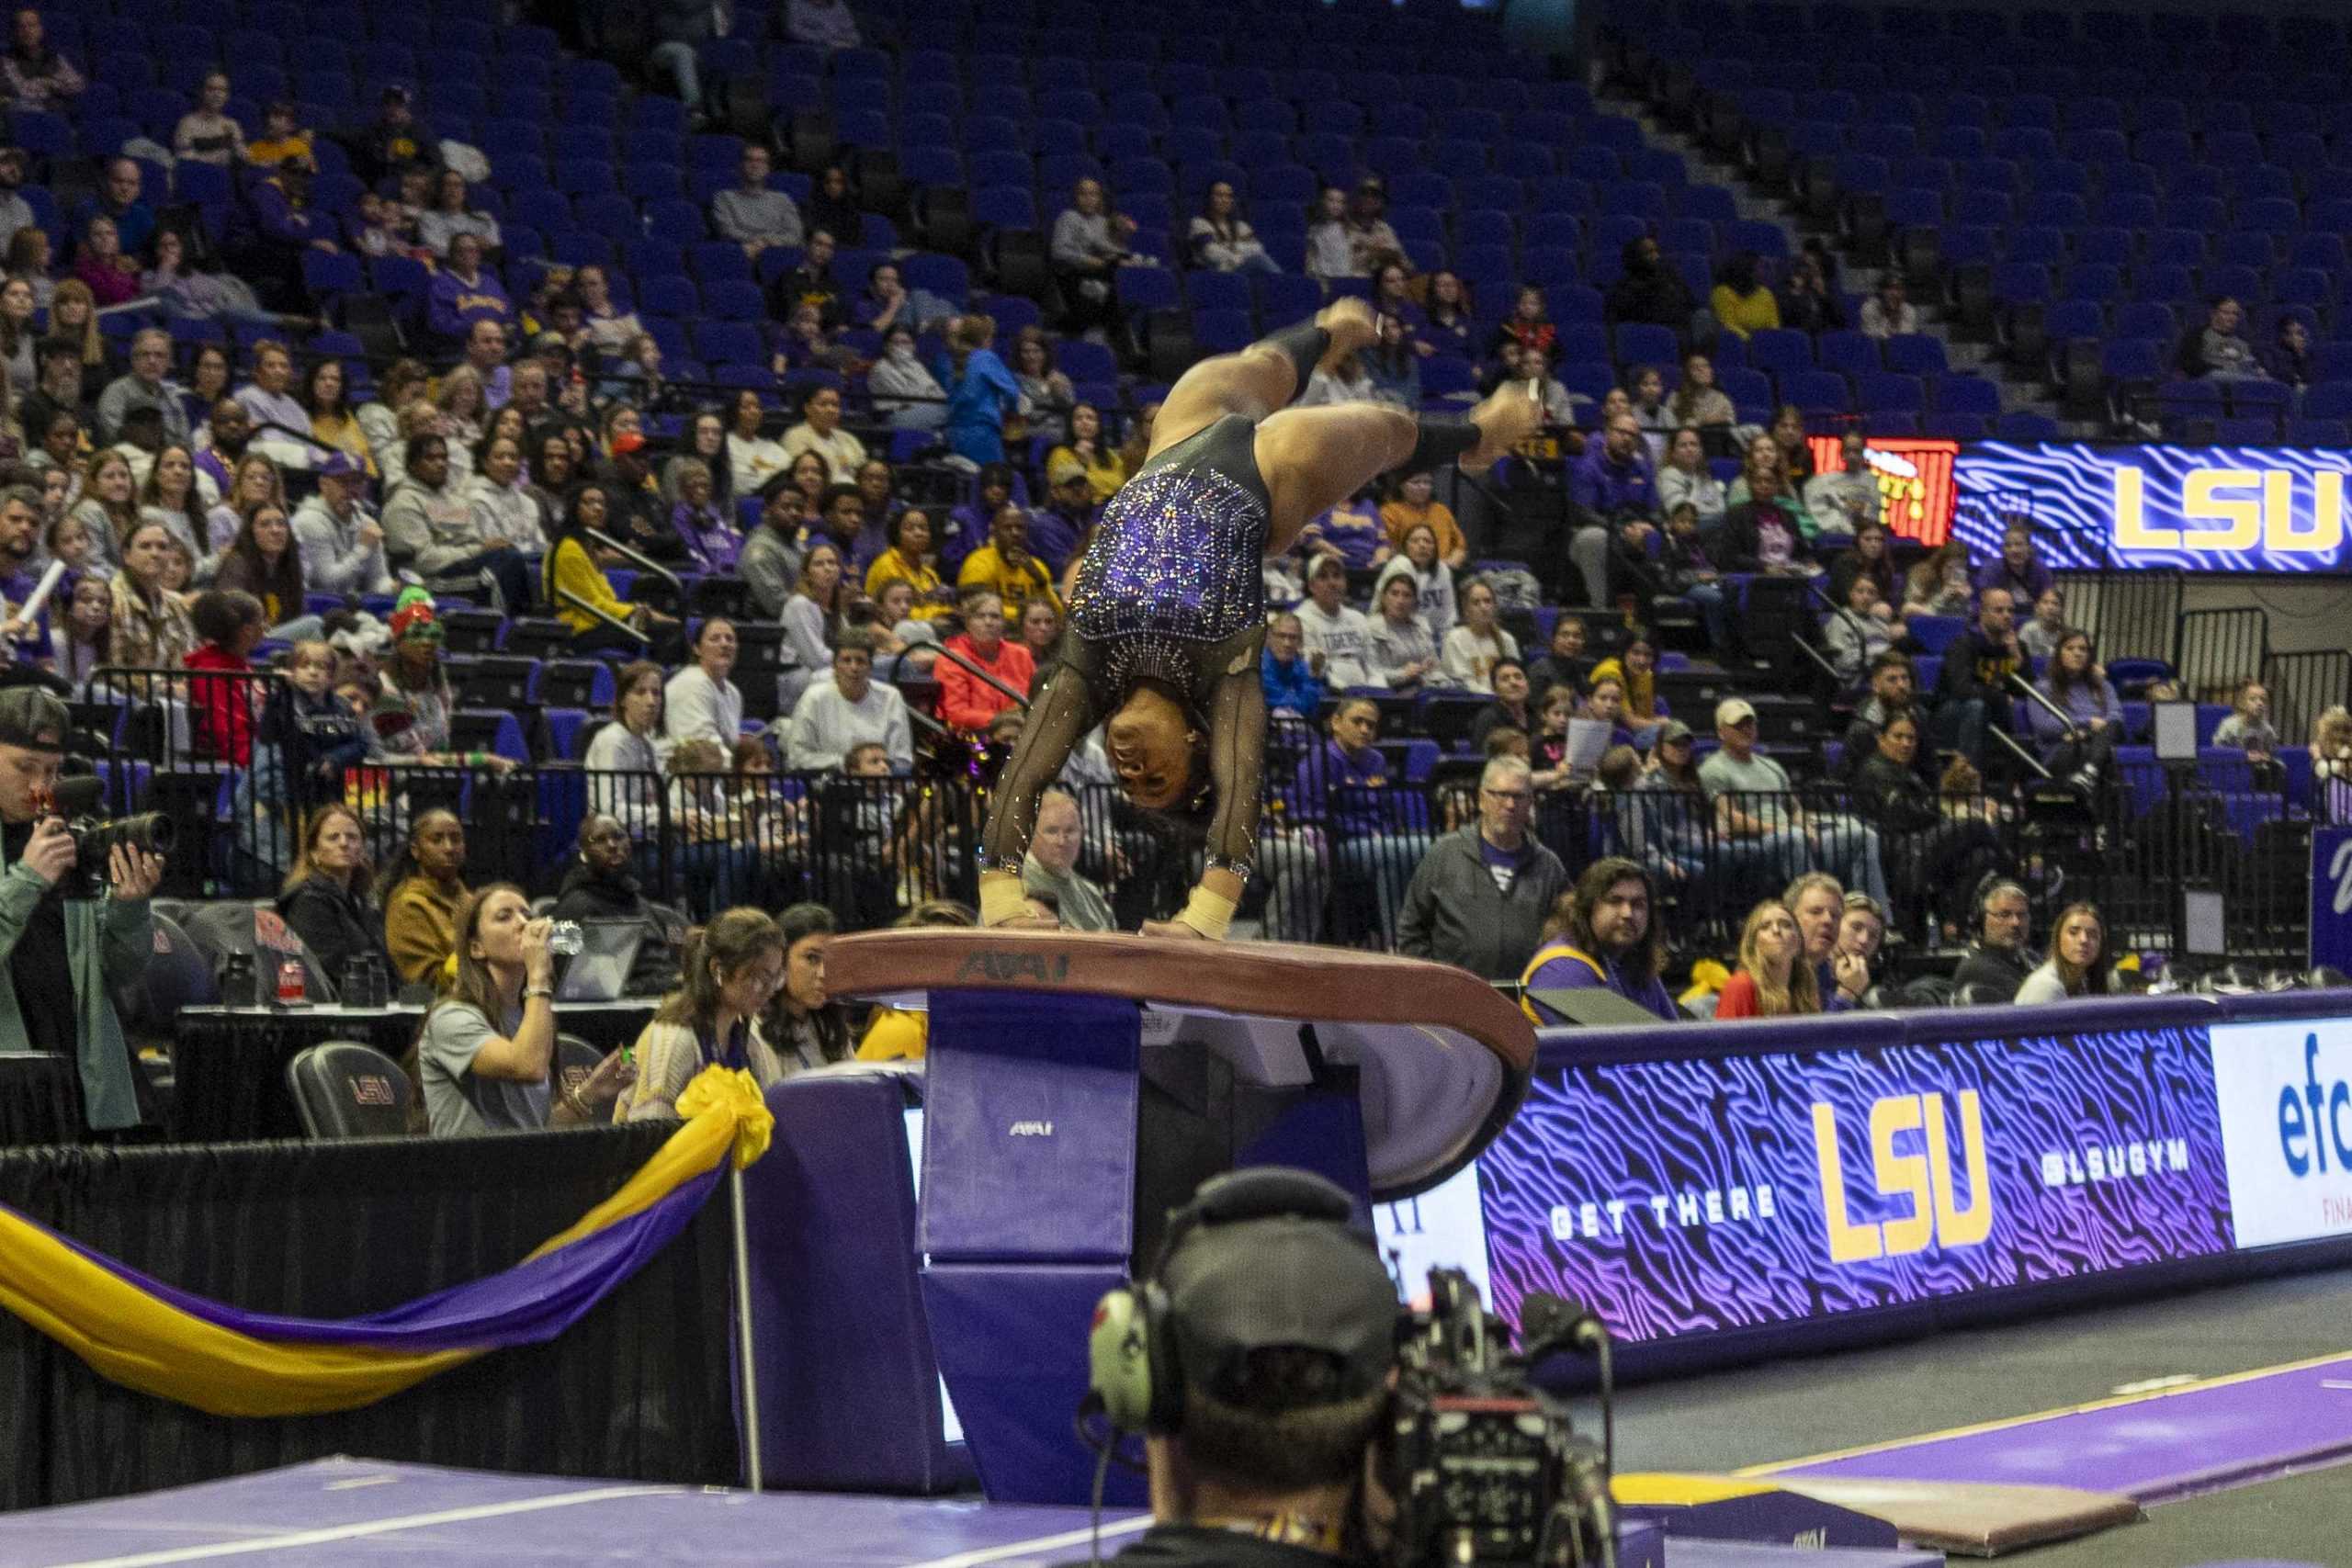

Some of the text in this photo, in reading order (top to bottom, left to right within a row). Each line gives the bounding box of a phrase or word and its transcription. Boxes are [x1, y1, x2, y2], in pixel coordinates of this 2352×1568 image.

[2114, 466, 2343, 551] LSU
[349, 1075, 395, 1105] LSU
[1812, 1089, 1993, 1263] LSU
[2041, 1136, 2189, 1187] @LSUGYM
[1550, 1184, 1775, 1240] GET THERE
